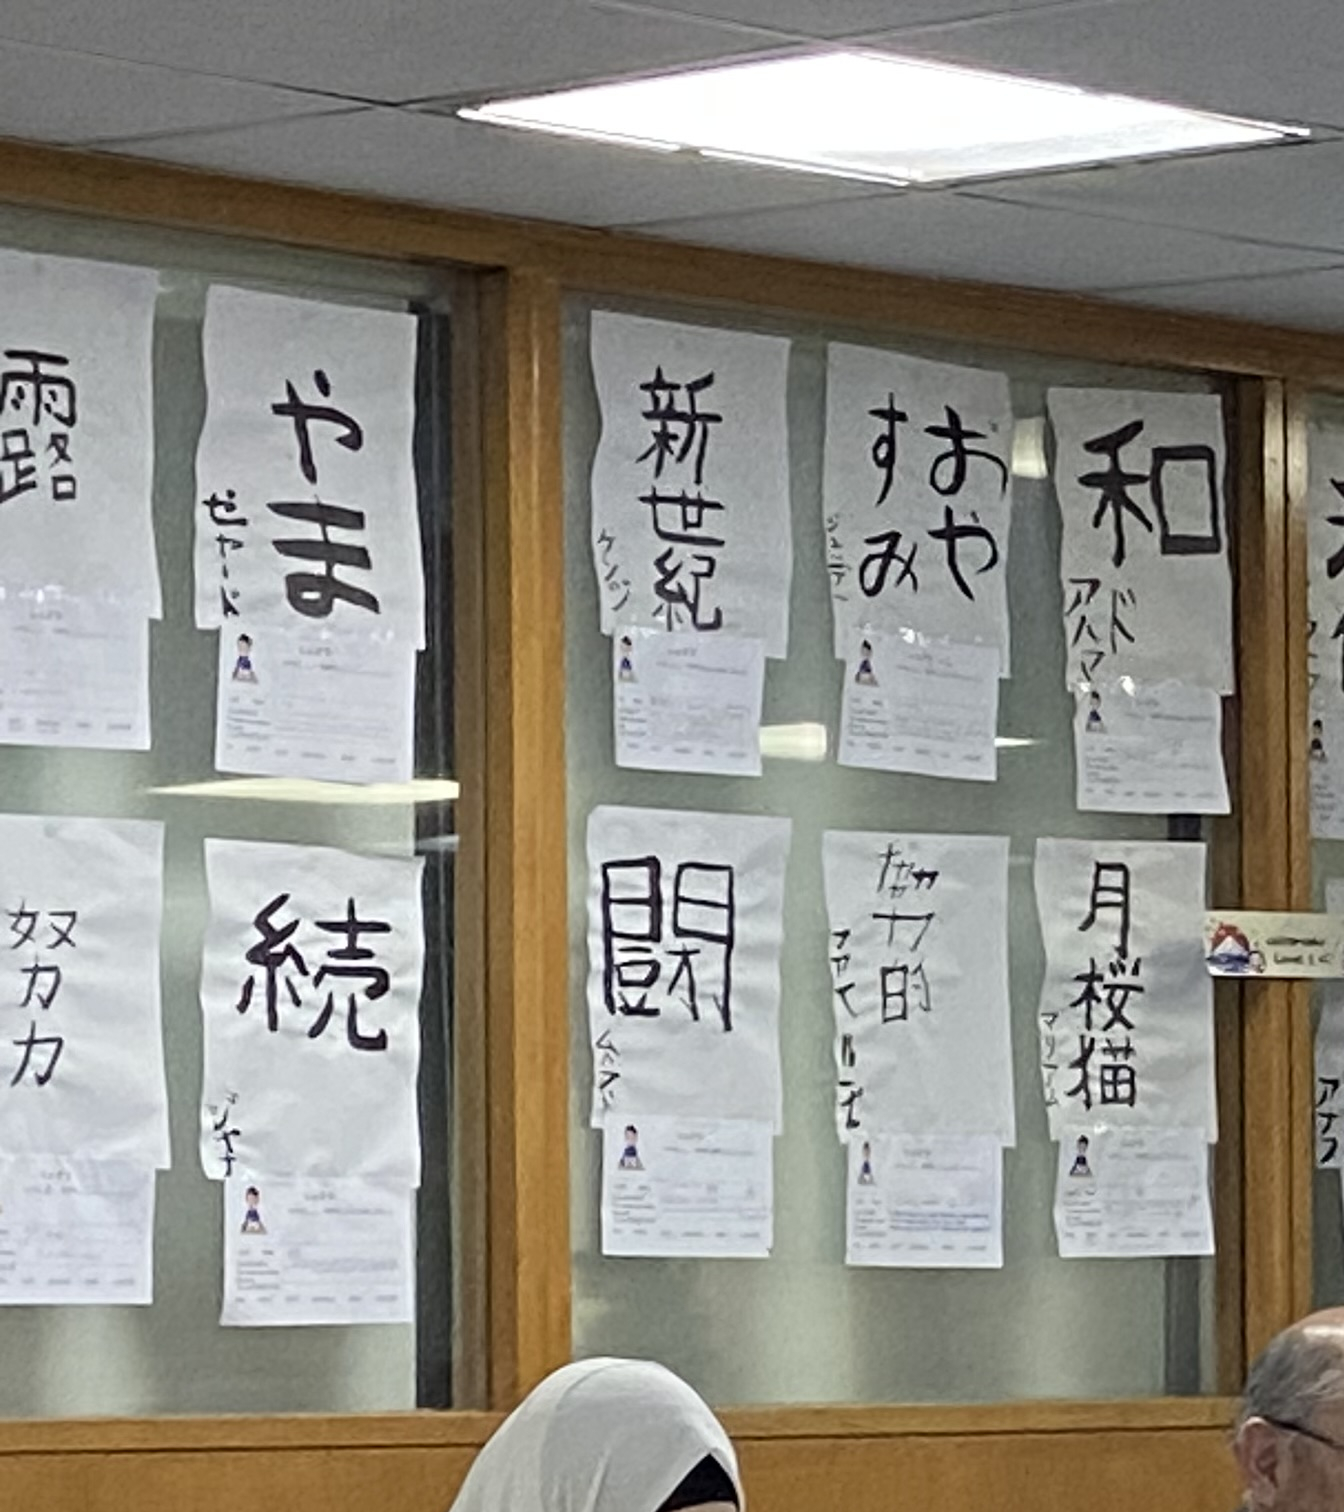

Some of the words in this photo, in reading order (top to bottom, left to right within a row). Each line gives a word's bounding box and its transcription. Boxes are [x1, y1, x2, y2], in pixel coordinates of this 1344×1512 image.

[265, 369, 381, 618] やま
[636, 365, 725, 632] 新世紀
[1077, 419, 1222, 568] 和
[236, 893, 392, 1052] 続
[1065, 862, 1144, 1111] 月桜猫
